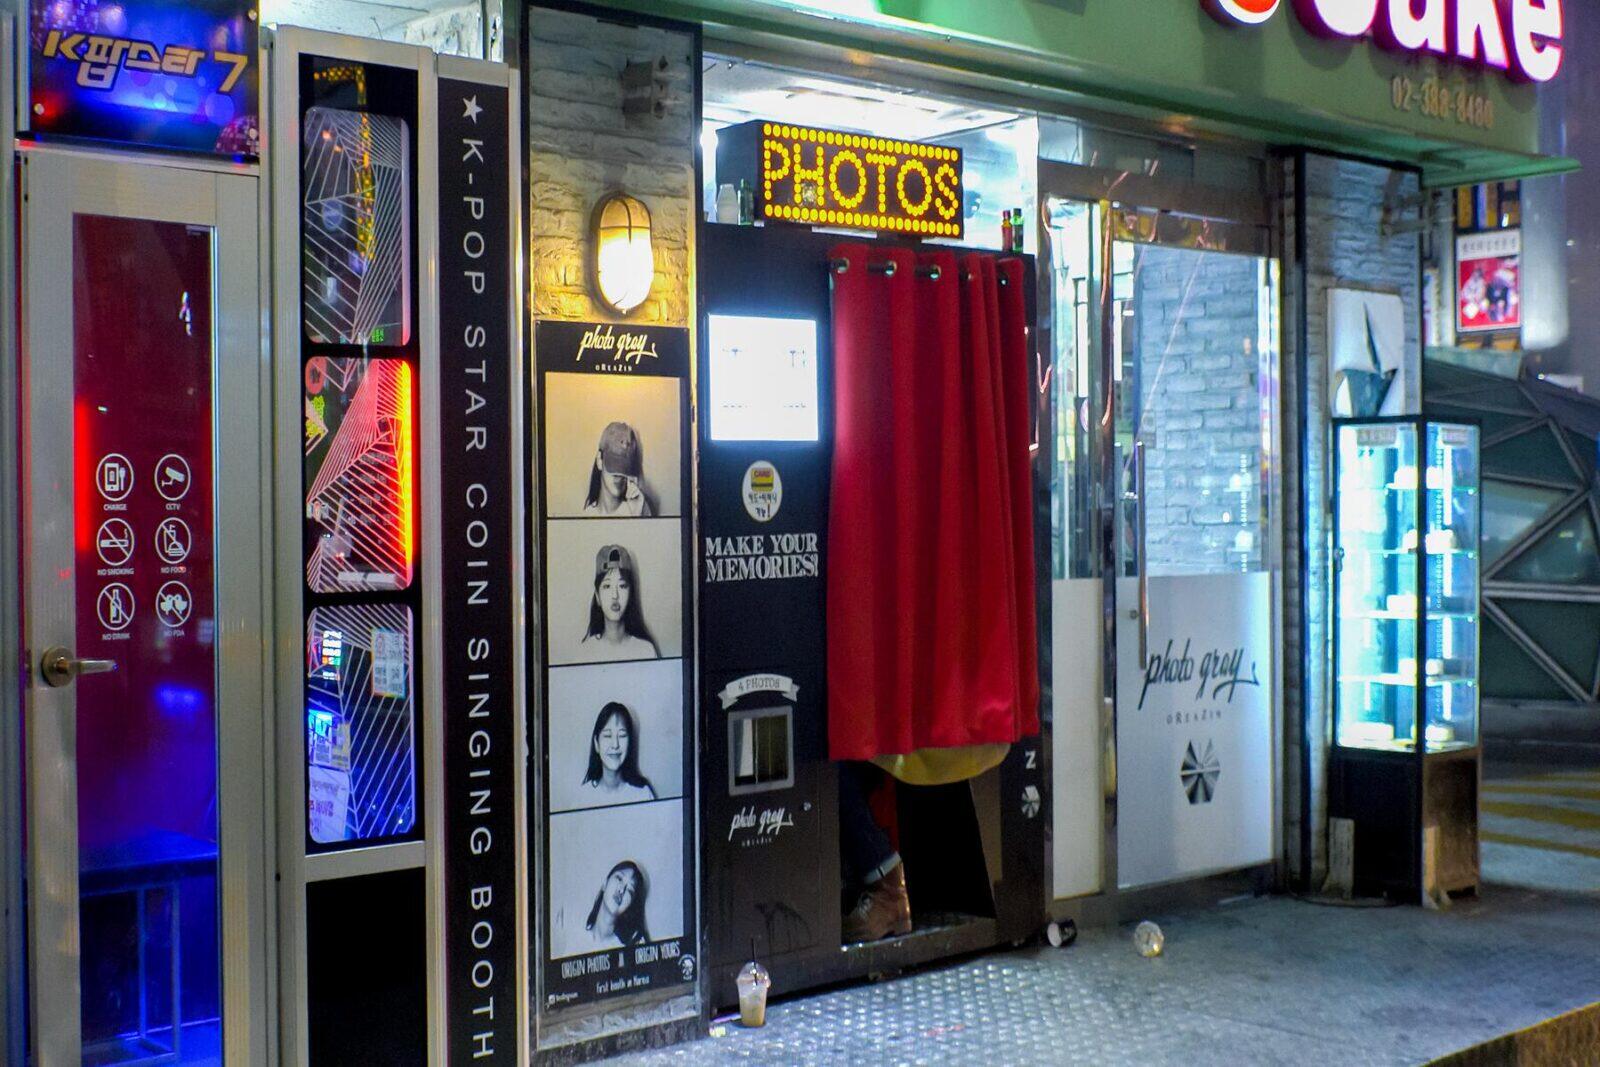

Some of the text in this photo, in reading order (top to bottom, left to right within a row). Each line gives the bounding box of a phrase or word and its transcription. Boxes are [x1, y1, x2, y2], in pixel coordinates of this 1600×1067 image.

[214, 51, 249, 93] 7
[763, 139, 959, 220] PHOTOS
[575, 324, 659, 365] photo gray
[103, 503, 128, 512] CHARGE
[165, 503, 181, 512] CCTV
[705, 533, 818, 557] MAKE YOUR
[97, 567, 134, 576] NO SMOKING
[160, 566, 171, 574] NO
[462, 138, 494, 1059] K-POP STAR COIN SINGING BOOTH
[746, 677, 780, 690] PHOTOS
[1137, 638, 1261, 711] photo gray
[728, 806, 795, 842] photo gray
[586, 954, 611, 974] PHOTOS
